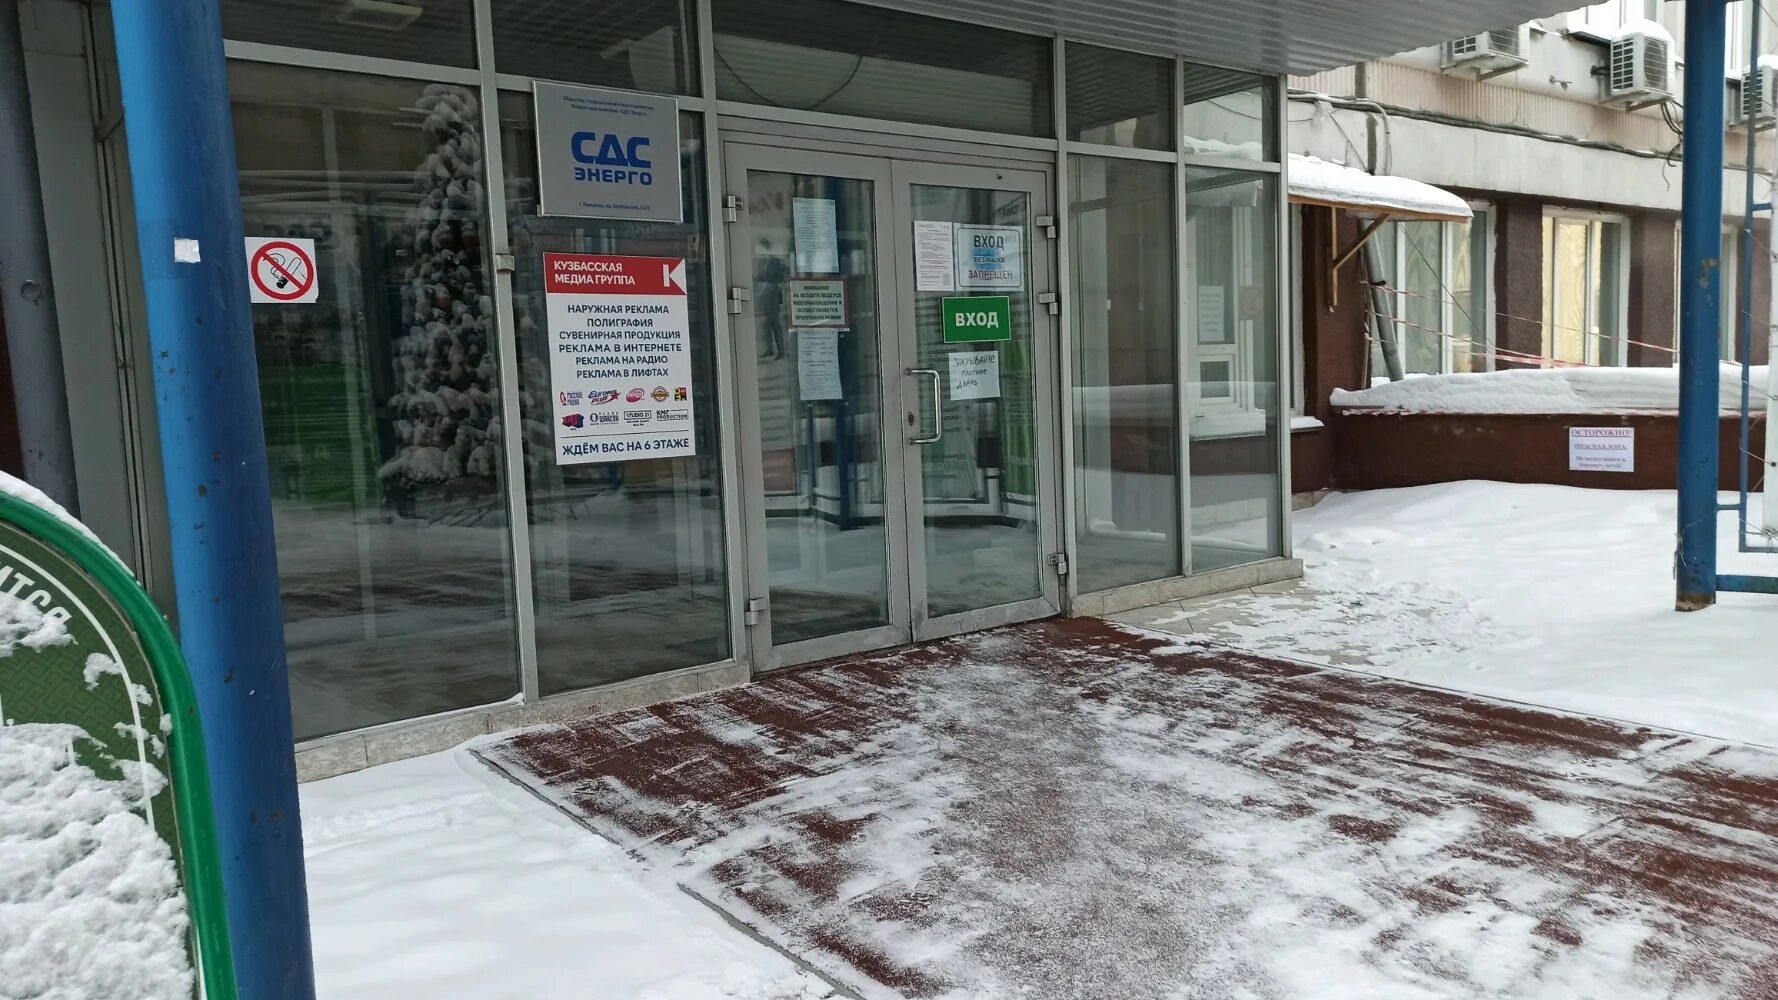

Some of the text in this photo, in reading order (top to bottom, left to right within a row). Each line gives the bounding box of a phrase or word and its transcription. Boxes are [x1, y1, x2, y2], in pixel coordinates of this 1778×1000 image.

[571, 131, 651, 168] СДС
[574, 167, 652, 185] ЭНЕРГО
[973, 234, 1004, 251] ВХОД
[554, 261, 623, 272] КУЗБАССКАЯ
[555, 274, 636, 285] МЕДИА ГРУППА
[968, 270, 1013, 280] ЗАПРЕЩЕН
[567, 305, 669, 314] НАРУЖНАЯ РЕКЛАМА
[587, 318, 653, 327] ПОЛИГРАФИЯ
[955, 312, 999, 328] ВХОД
[559, 331, 681, 341] СУВЕНИРНАЯ ПРОДУКЦИЯ
[559, 343, 682, 353] РЕКЛАМА В ИНТЕРНЕТЕ
[576, 355, 668, 365] РЕКЛАМА НА РАДИО
[577, 368, 669, 378] РЕКЛАМА В ЛИФТАХ
[562, 438, 689, 456] ЖДЁМ ВАС НА 6 ЭТАЖЕ
